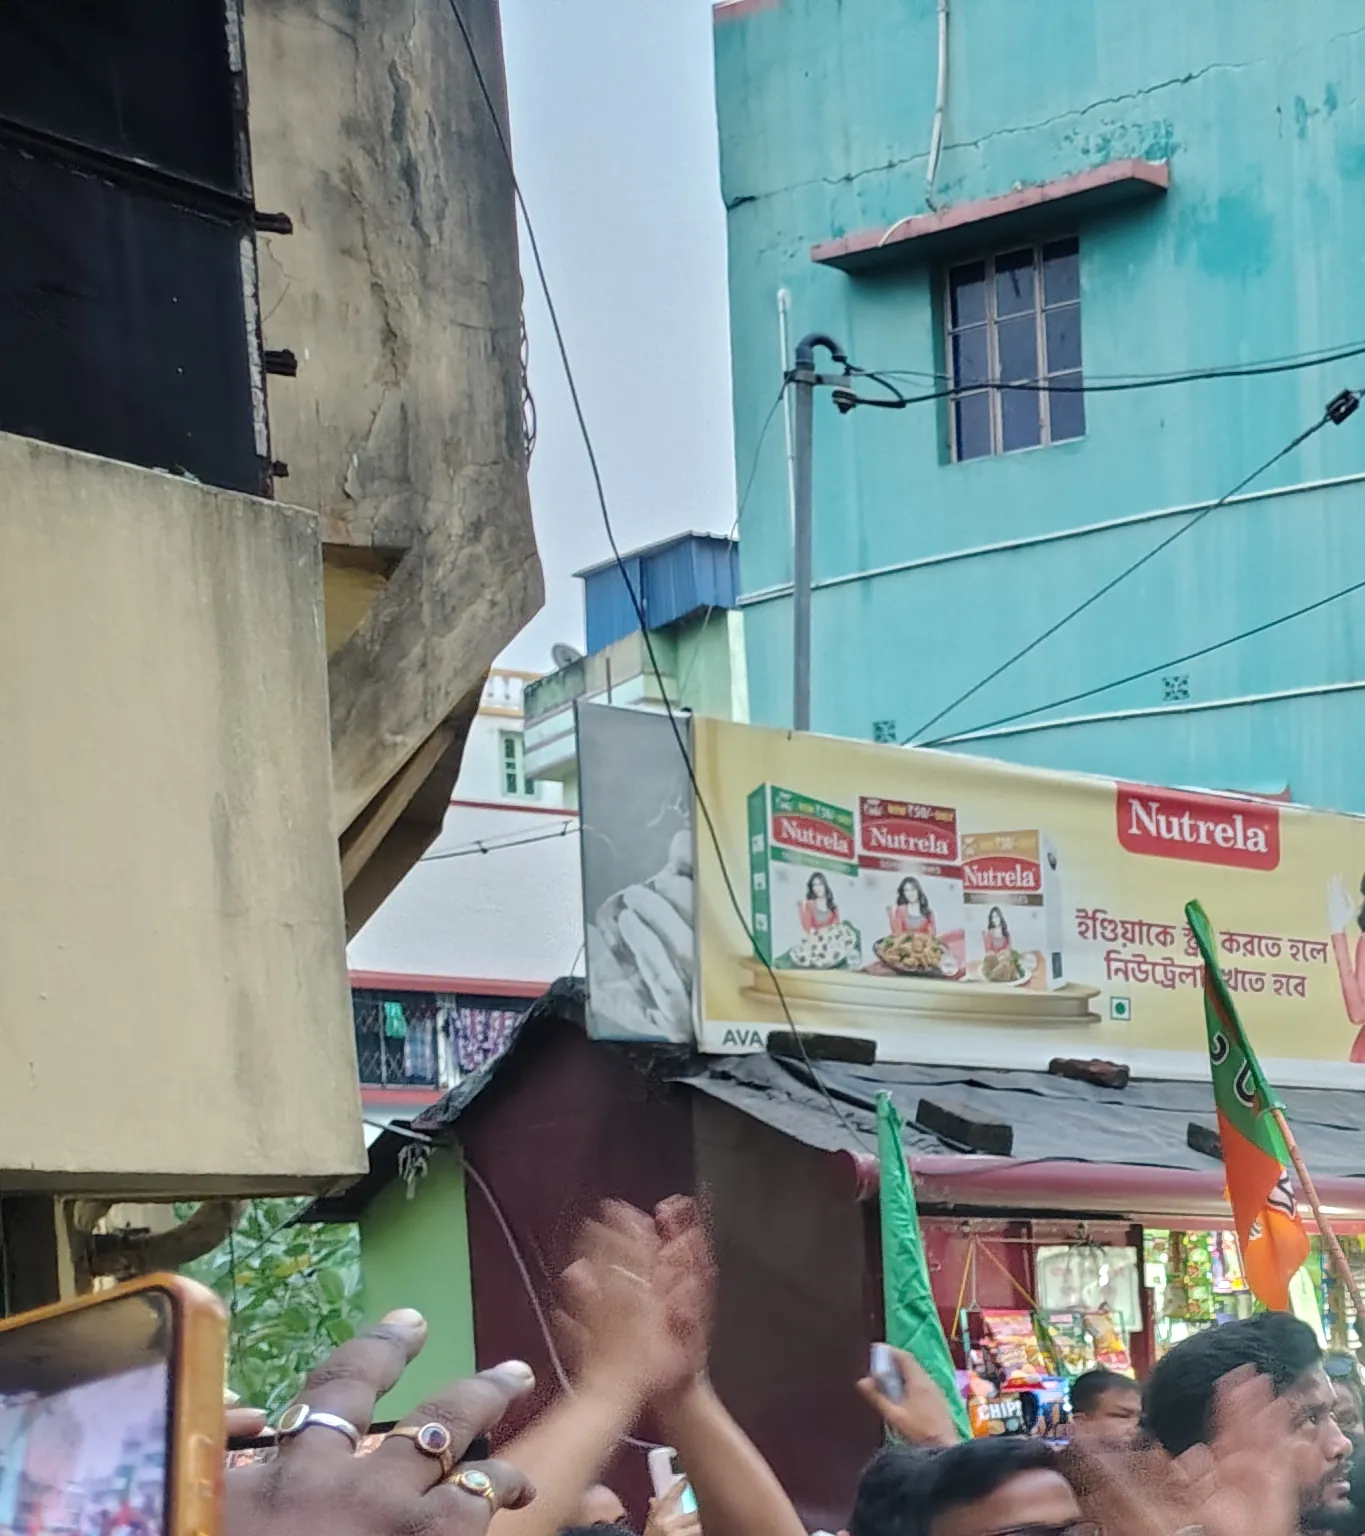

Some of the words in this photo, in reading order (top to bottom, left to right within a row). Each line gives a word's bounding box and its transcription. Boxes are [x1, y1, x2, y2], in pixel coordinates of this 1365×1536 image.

[780, 817, 848, 855] Nutrela
[1128, 798, 1268, 853] Nutrela
[870, 826, 949, 855] Nutrela
[963, 863, 1035, 888] Nutrela
[1219, 931, 1282, 958] করতে
[1288, 937, 1328, 963] হলে
[1272, 973, 1307, 997] হবে
[722, 1028, 764, 1046] AVA
